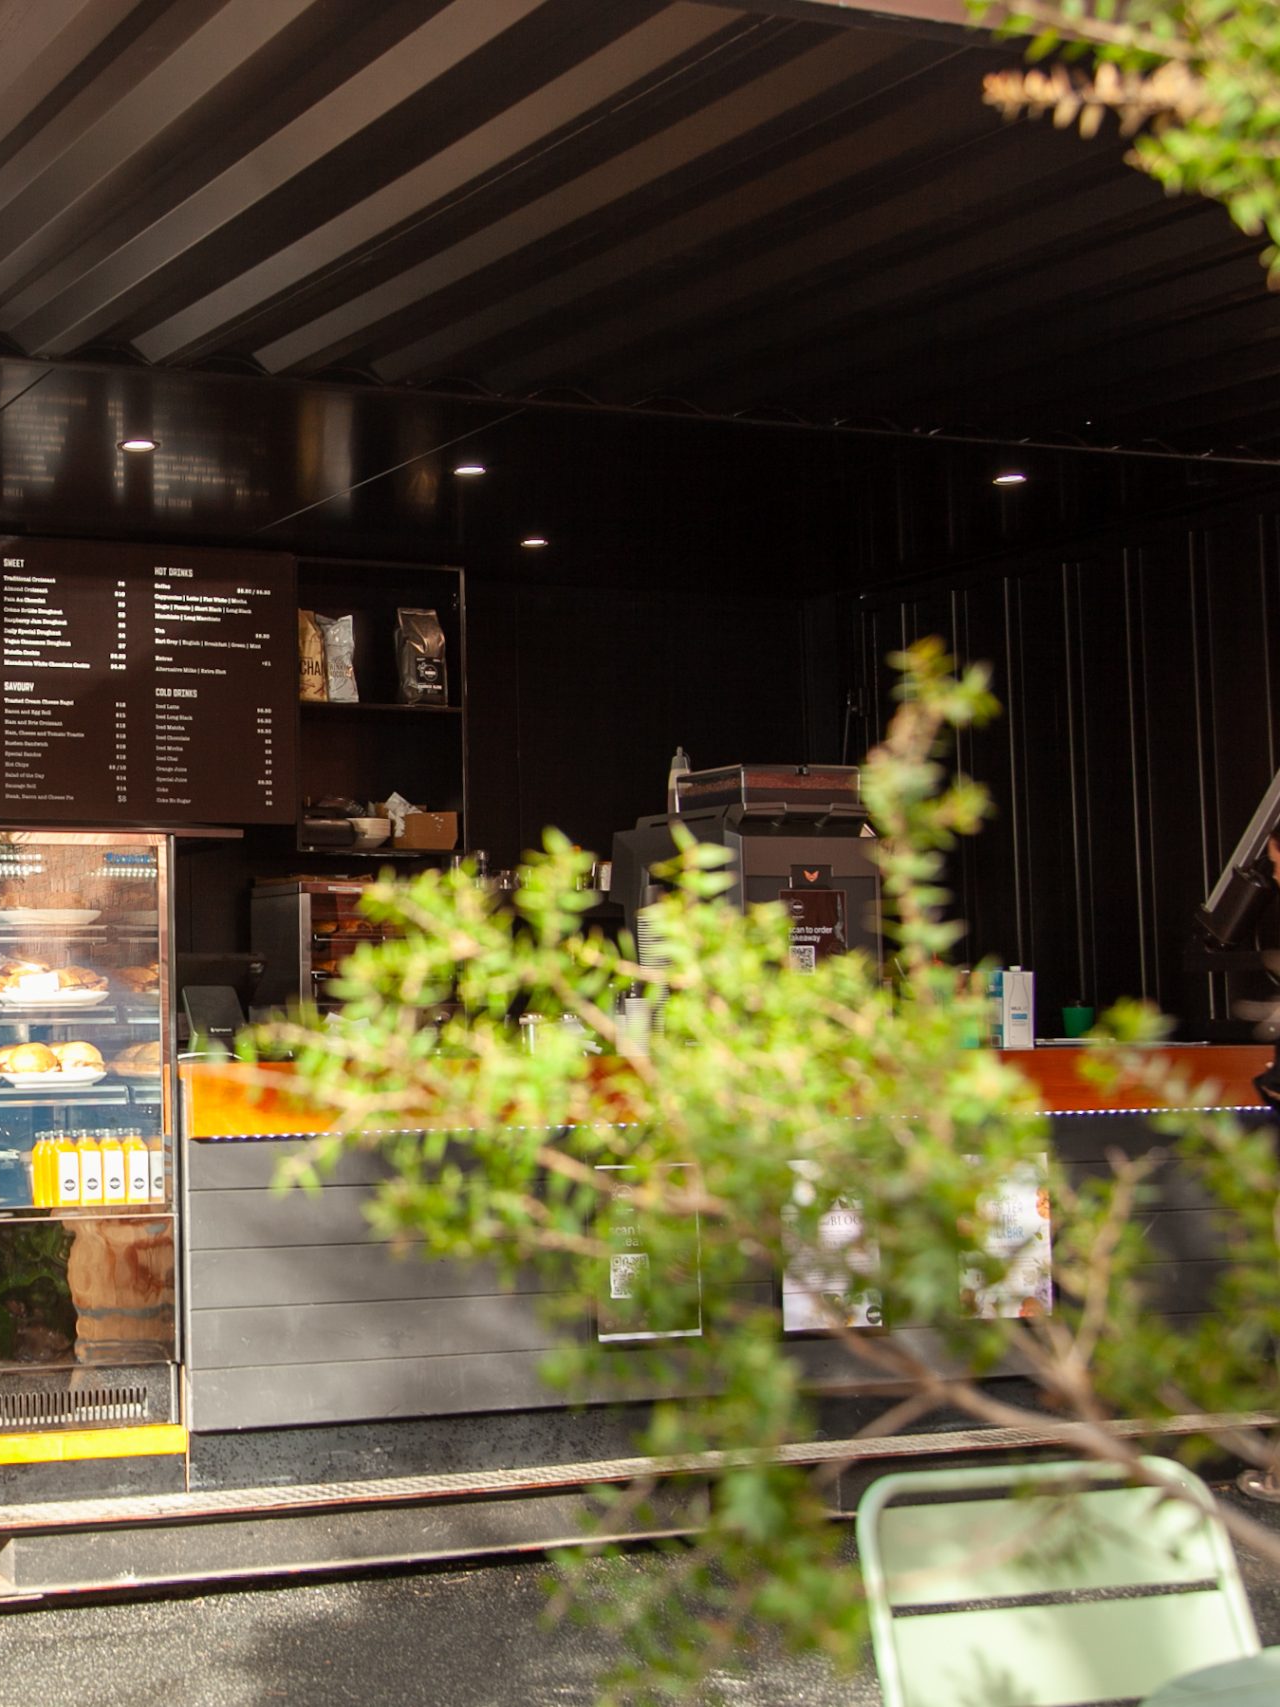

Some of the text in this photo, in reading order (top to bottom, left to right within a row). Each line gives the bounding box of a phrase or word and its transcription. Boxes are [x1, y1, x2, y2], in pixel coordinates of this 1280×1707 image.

[4, 559, 24, 568] SWEET
[155, 567, 193, 577] HOT DRINKS
[4, 682, 34, 691] SAVOURY
[156, 688, 197, 698] COLD DRINKS
